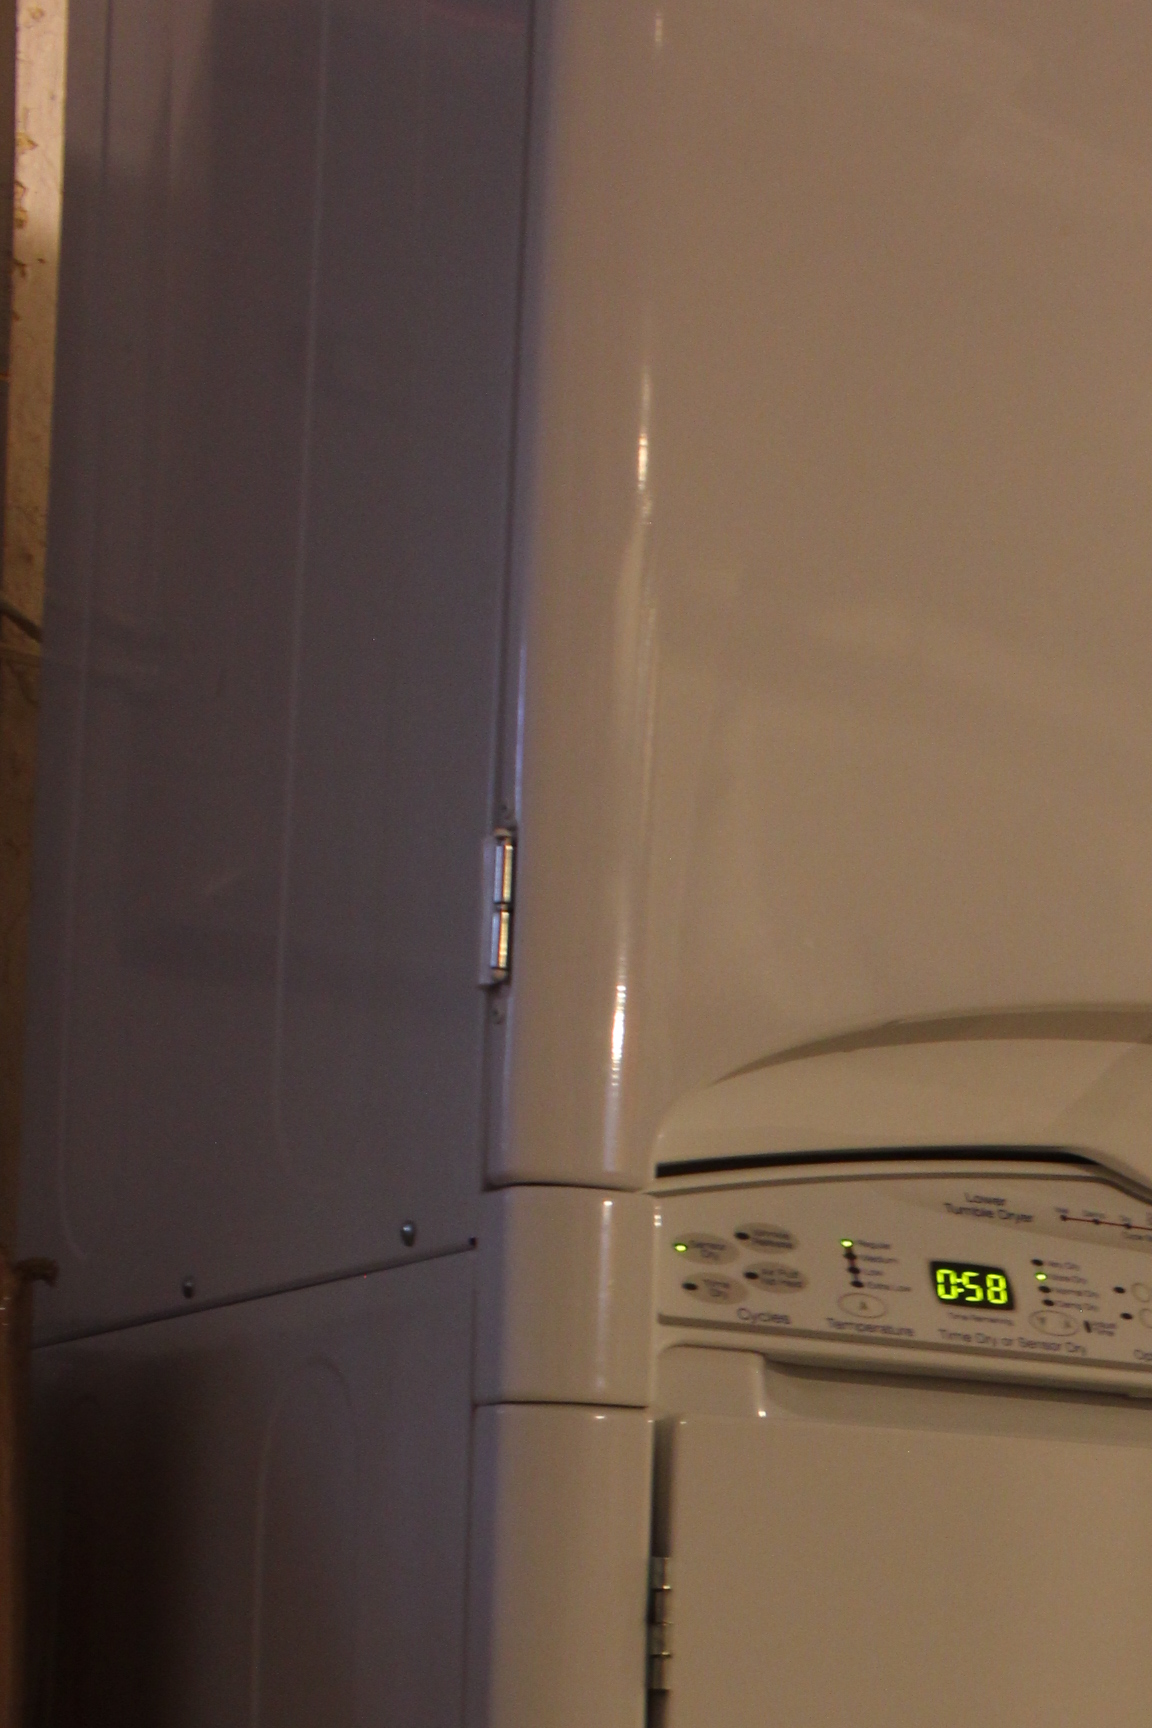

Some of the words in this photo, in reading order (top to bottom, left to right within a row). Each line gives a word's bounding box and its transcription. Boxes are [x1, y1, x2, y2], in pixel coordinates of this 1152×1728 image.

[936, 1269, 1008, 1304] 0:58
[736, 1308, 792, 1326] Cycles
[826, 1317, 915, 1337] Temperature
[937, 1328, 972, 1342] Time
[974, 1332, 997, 1347] Dry
[1017, 1336, 1062, 1351] Sensor
[1065, 1341, 1087, 1356] Dry
